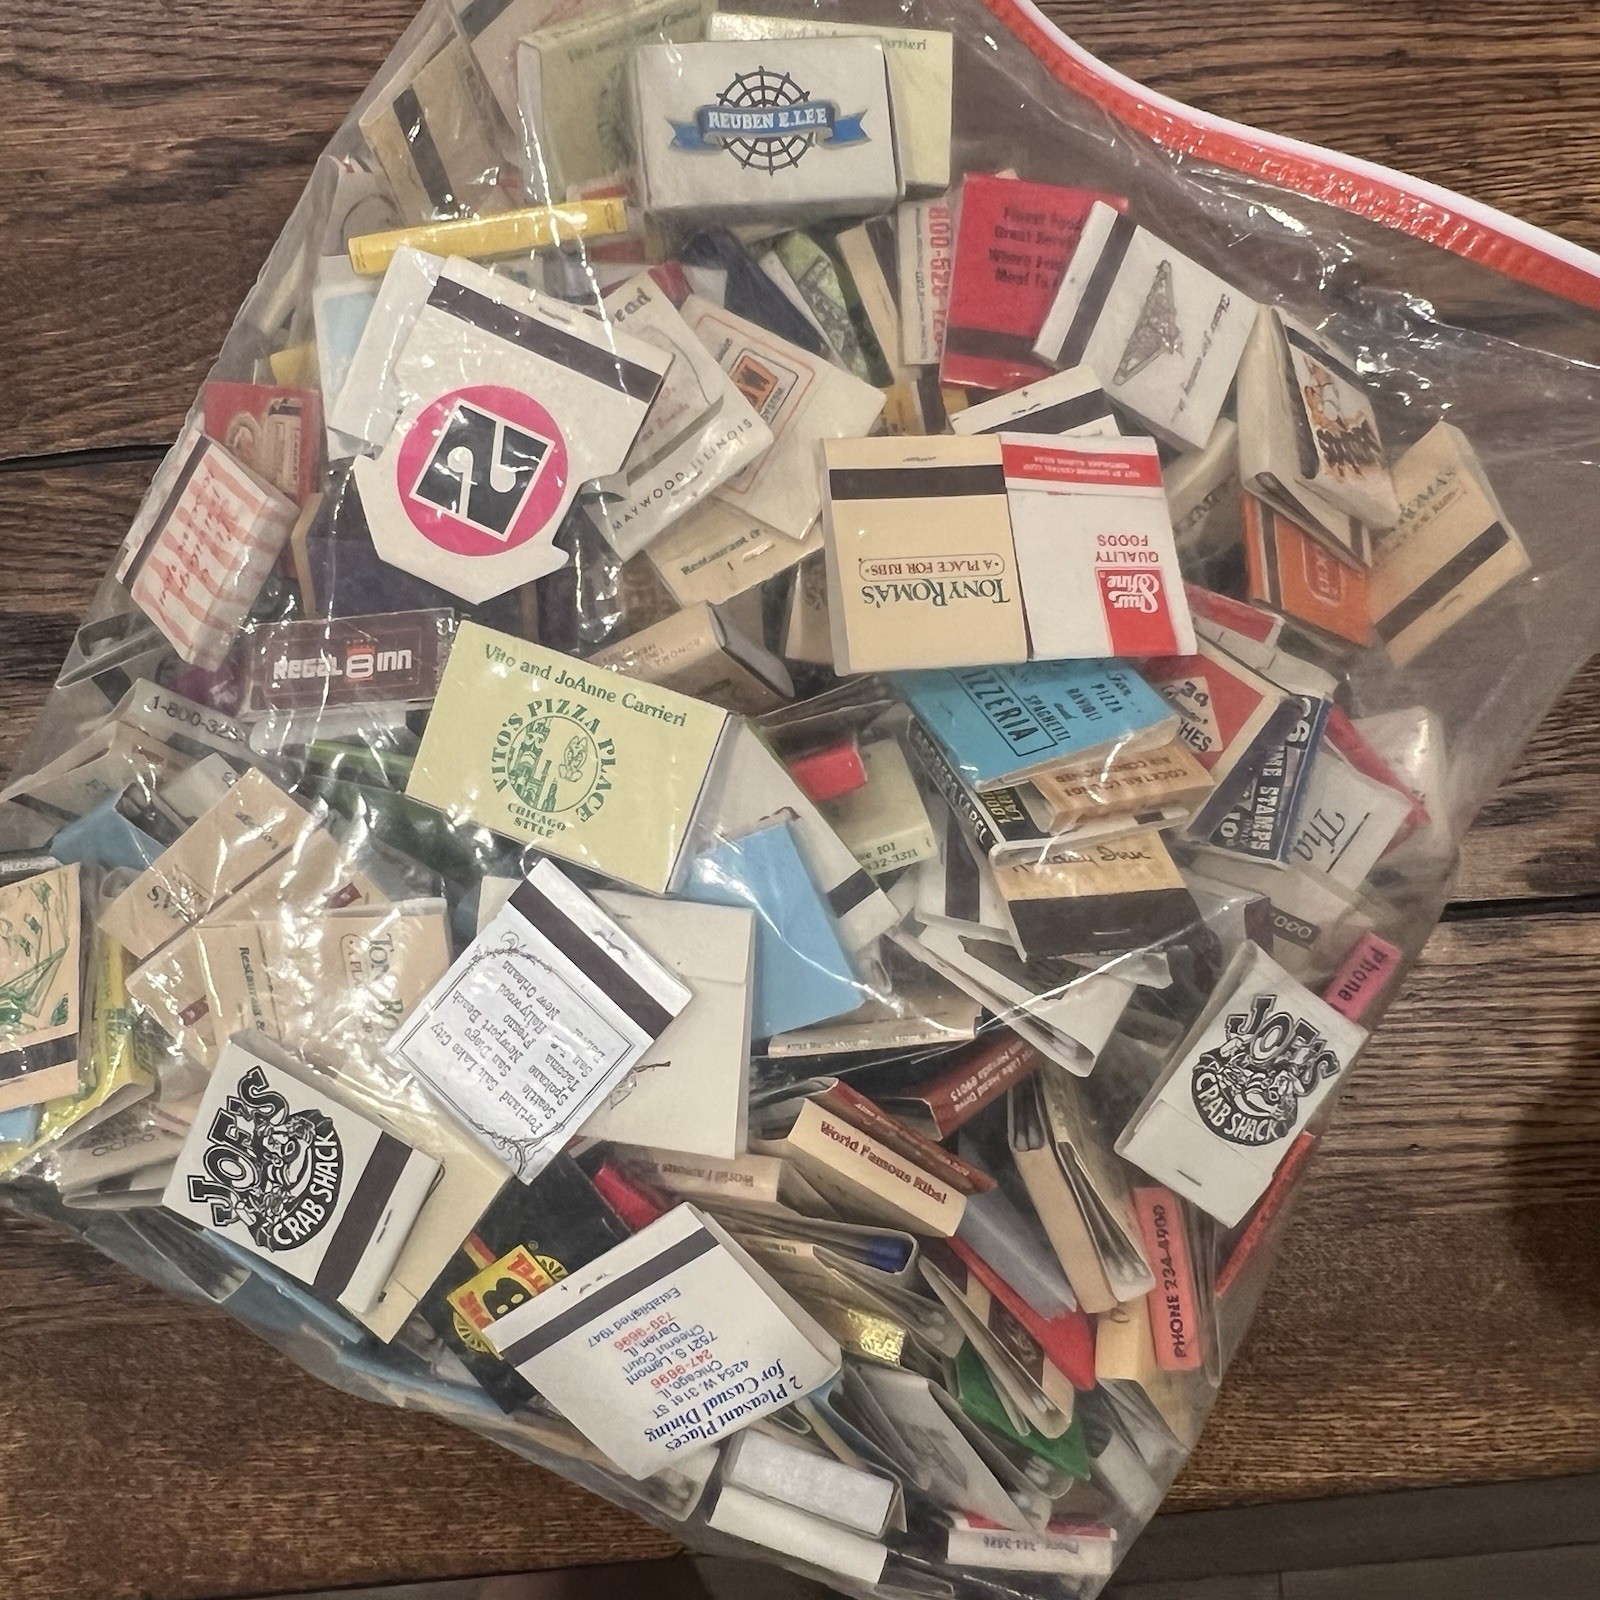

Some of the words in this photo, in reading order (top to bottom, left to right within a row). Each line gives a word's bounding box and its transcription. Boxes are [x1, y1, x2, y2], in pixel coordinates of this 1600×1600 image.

[707, 109, 775, 130] REUBEN
[612, 470, 685, 533] MAYWOOD
[1094, 550, 1160, 564] QUALITY
[1096, 534, 1149, 548] FOODS
[870, 563, 903, 576] RIBS
[908, 561, 933, 575] FOR
[936, 560, 980, 573] PLACE
[861, 579, 949, 608] ROMA'S
[949, 578, 1011, 605] TONY
[485, 643, 516, 668] Vito
[519, 658, 553, 680] and
[554, 670, 617, 703] JoAnne
[621, 692, 688, 728] Carrieri
[1090, 683, 1125, 714] PIZZA
[958, 667, 1040, 743] IZZERIA
[1021, 694, 1071, 742] SPAGHETTI
[1064, 687, 1104, 722] RAVIOLI
[490, 712, 525, 793] VITO'S
[527, 697, 603, 735] PIZZA
[575, 737, 617, 823] PLACE
[1119, 767, 1189, 790] COCKTAIL
[506, 801, 568, 832] CHICAGO
[513, 816, 555, 839] STYLE
[1249, 785, 1280, 851] STAMPS
[502, 960, 536, 998] Orleans
[1337, 947, 1388, 1001] Phone
[453, 990, 482, 1023] Beach
[536, 996, 560, 1020] New
[430, 1022, 452, 1046] City
[474, 1020, 523, 1064] Newport
[503, 1015, 536, 1049] Fresno
[1225, 994, 1342, 1098] JOE'S
[452, 1043, 480, 1072] Lake
[492, 1055, 511, 1077] San
[545, 1054, 580, 1092] Tacoma
[573, 1054, 593, 1077] San
[499, 1091, 543, 1135] Portland
[522, 1084, 556, 1119] Seattle
[1196, 1073, 1228, 1127] CRAB
[1224, 1112, 1279, 1142] SHACK
[187, 1065, 290, 1227] JOE'S
[819, 1120, 861, 1153] World
[860, 1144, 912, 1186] Famous
[913, 1175, 947, 1205] Ribs!
[272, 1202, 326, 1246] CRAB
[309, 1130, 339, 1202] SHACK
[613, 1285, 681, 1330] Established
[588, 1328, 614, 1347] 1947
[1166, 1298, 1187, 1360] PHONE
[622, 1352, 656, 1373] Court
[624, 1347, 639, 1356] IL
[762, 1359, 784, 1382] for
[789, 1376, 803, 1389] 2
[656, 1389, 671, 1399] IL
[702, 1377, 759, 1416] Casual
[717, 1378, 788, 1427] Pleasant
[644, 1408, 702, 1442] Dining
[652, 1404, 670, 1419] ST
[665, 1420, 719, 1452] Places
